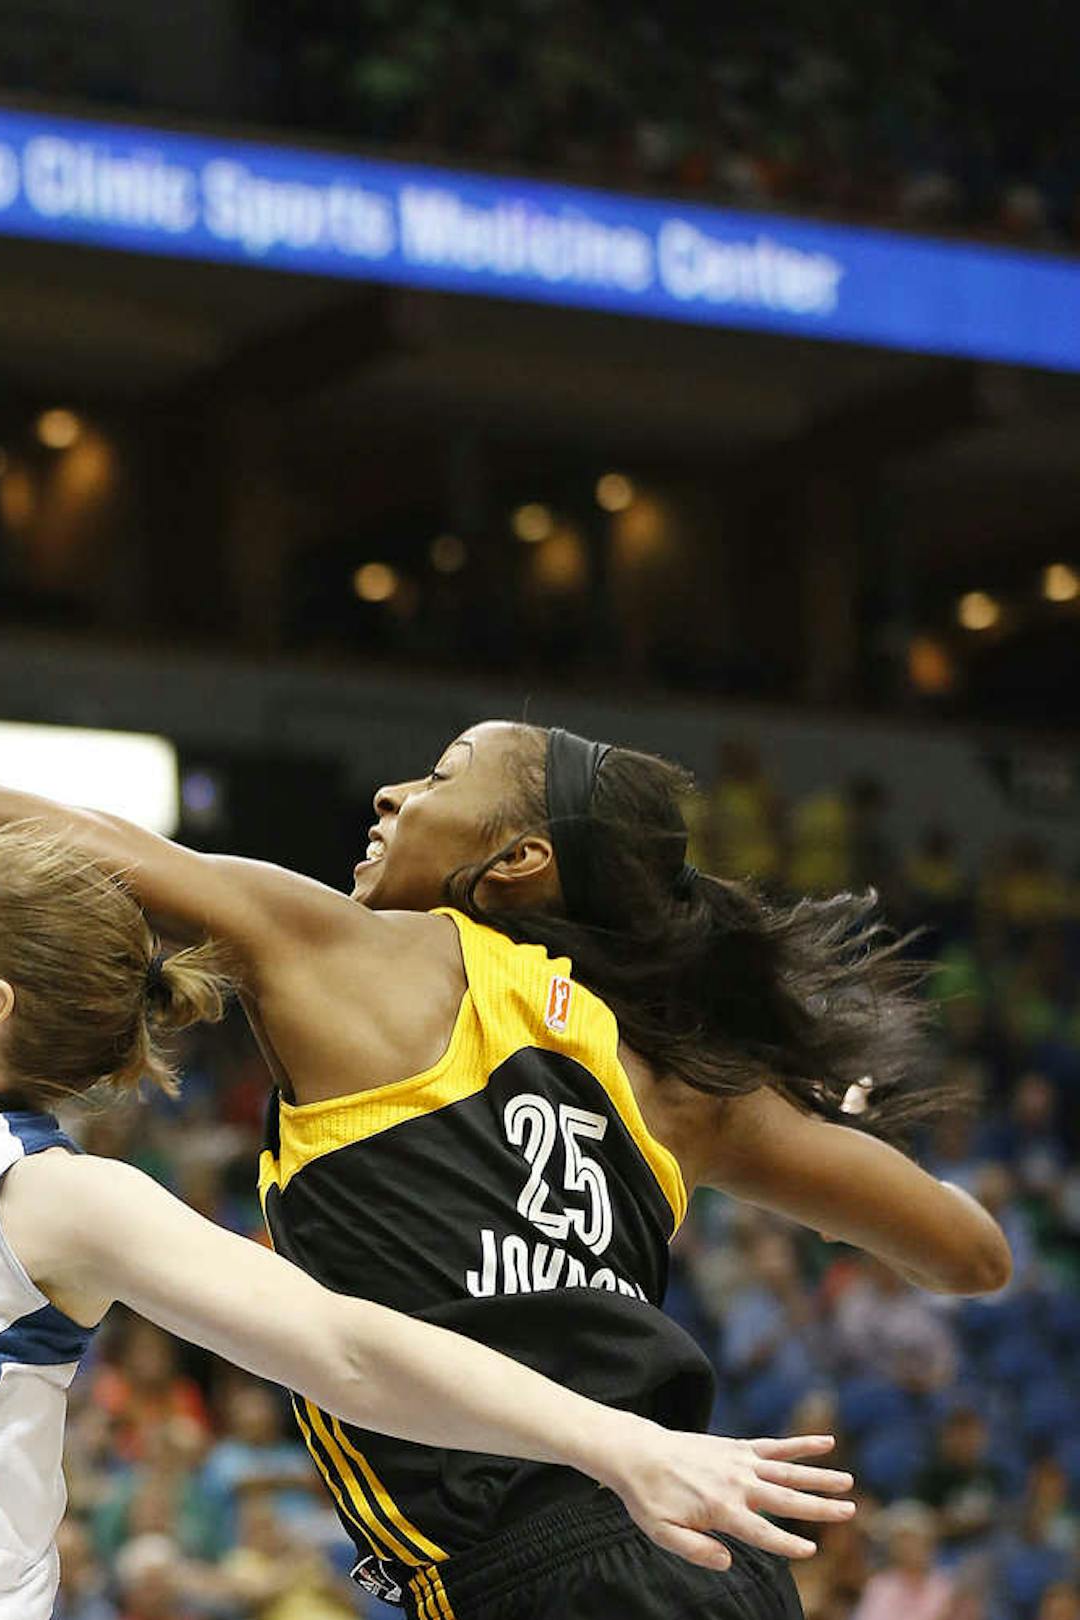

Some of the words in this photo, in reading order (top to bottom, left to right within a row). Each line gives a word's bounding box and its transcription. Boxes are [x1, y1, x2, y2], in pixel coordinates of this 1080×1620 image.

[21, 133, 198, 234] Clinic
[200, 156, 395, 258] Sports
[398, 183, 654, 293] Medicine
[657, 218, 844, 317] Center
[504, 1093, 612, 1256] 25
